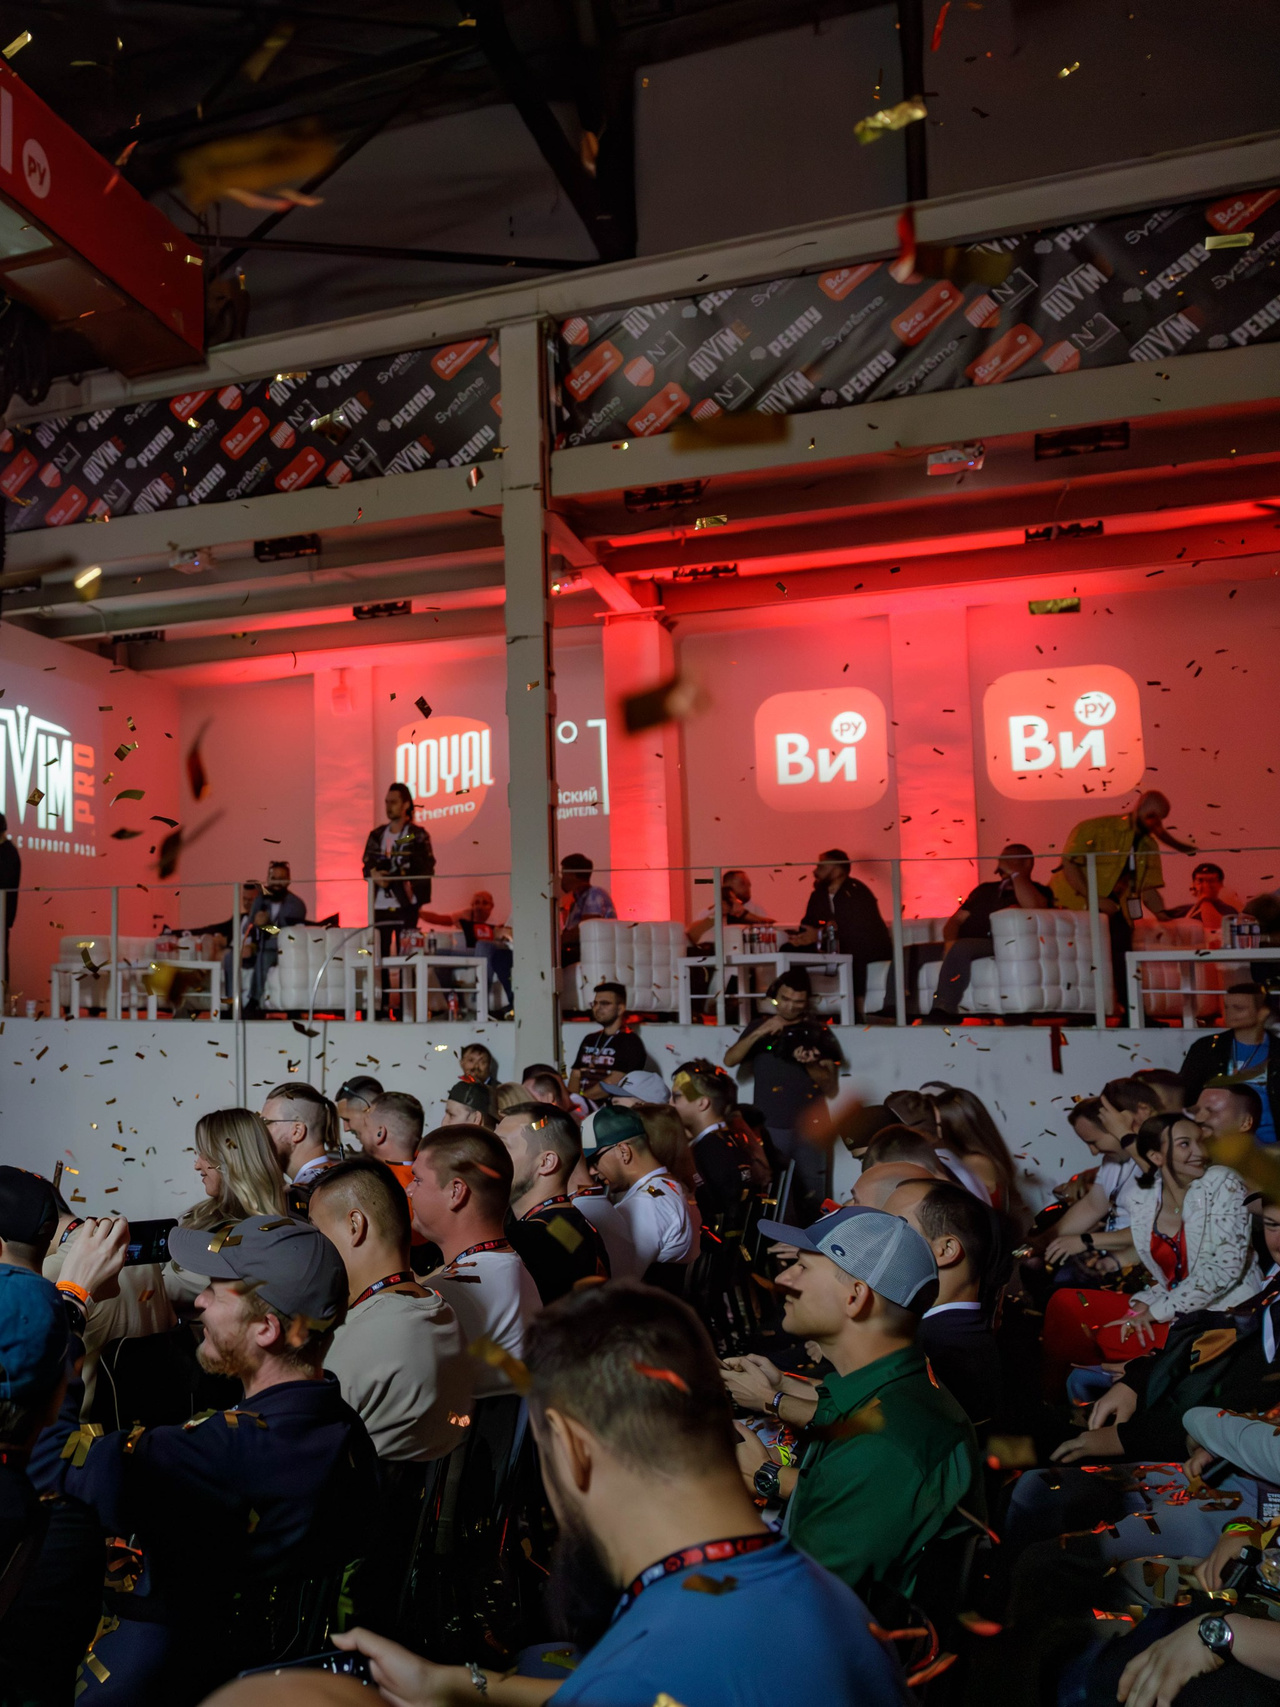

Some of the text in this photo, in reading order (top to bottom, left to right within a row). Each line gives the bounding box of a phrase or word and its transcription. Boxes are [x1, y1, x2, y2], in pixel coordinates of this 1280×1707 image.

[73, 742, 95, 825] PRO
[395, 728, 496, 800] ROYAL
[415, 800, 476, 823] thermo
[28, 836, 70, 854] ПЕРВОГО
[74, 843, 97, 857] РАЗА
